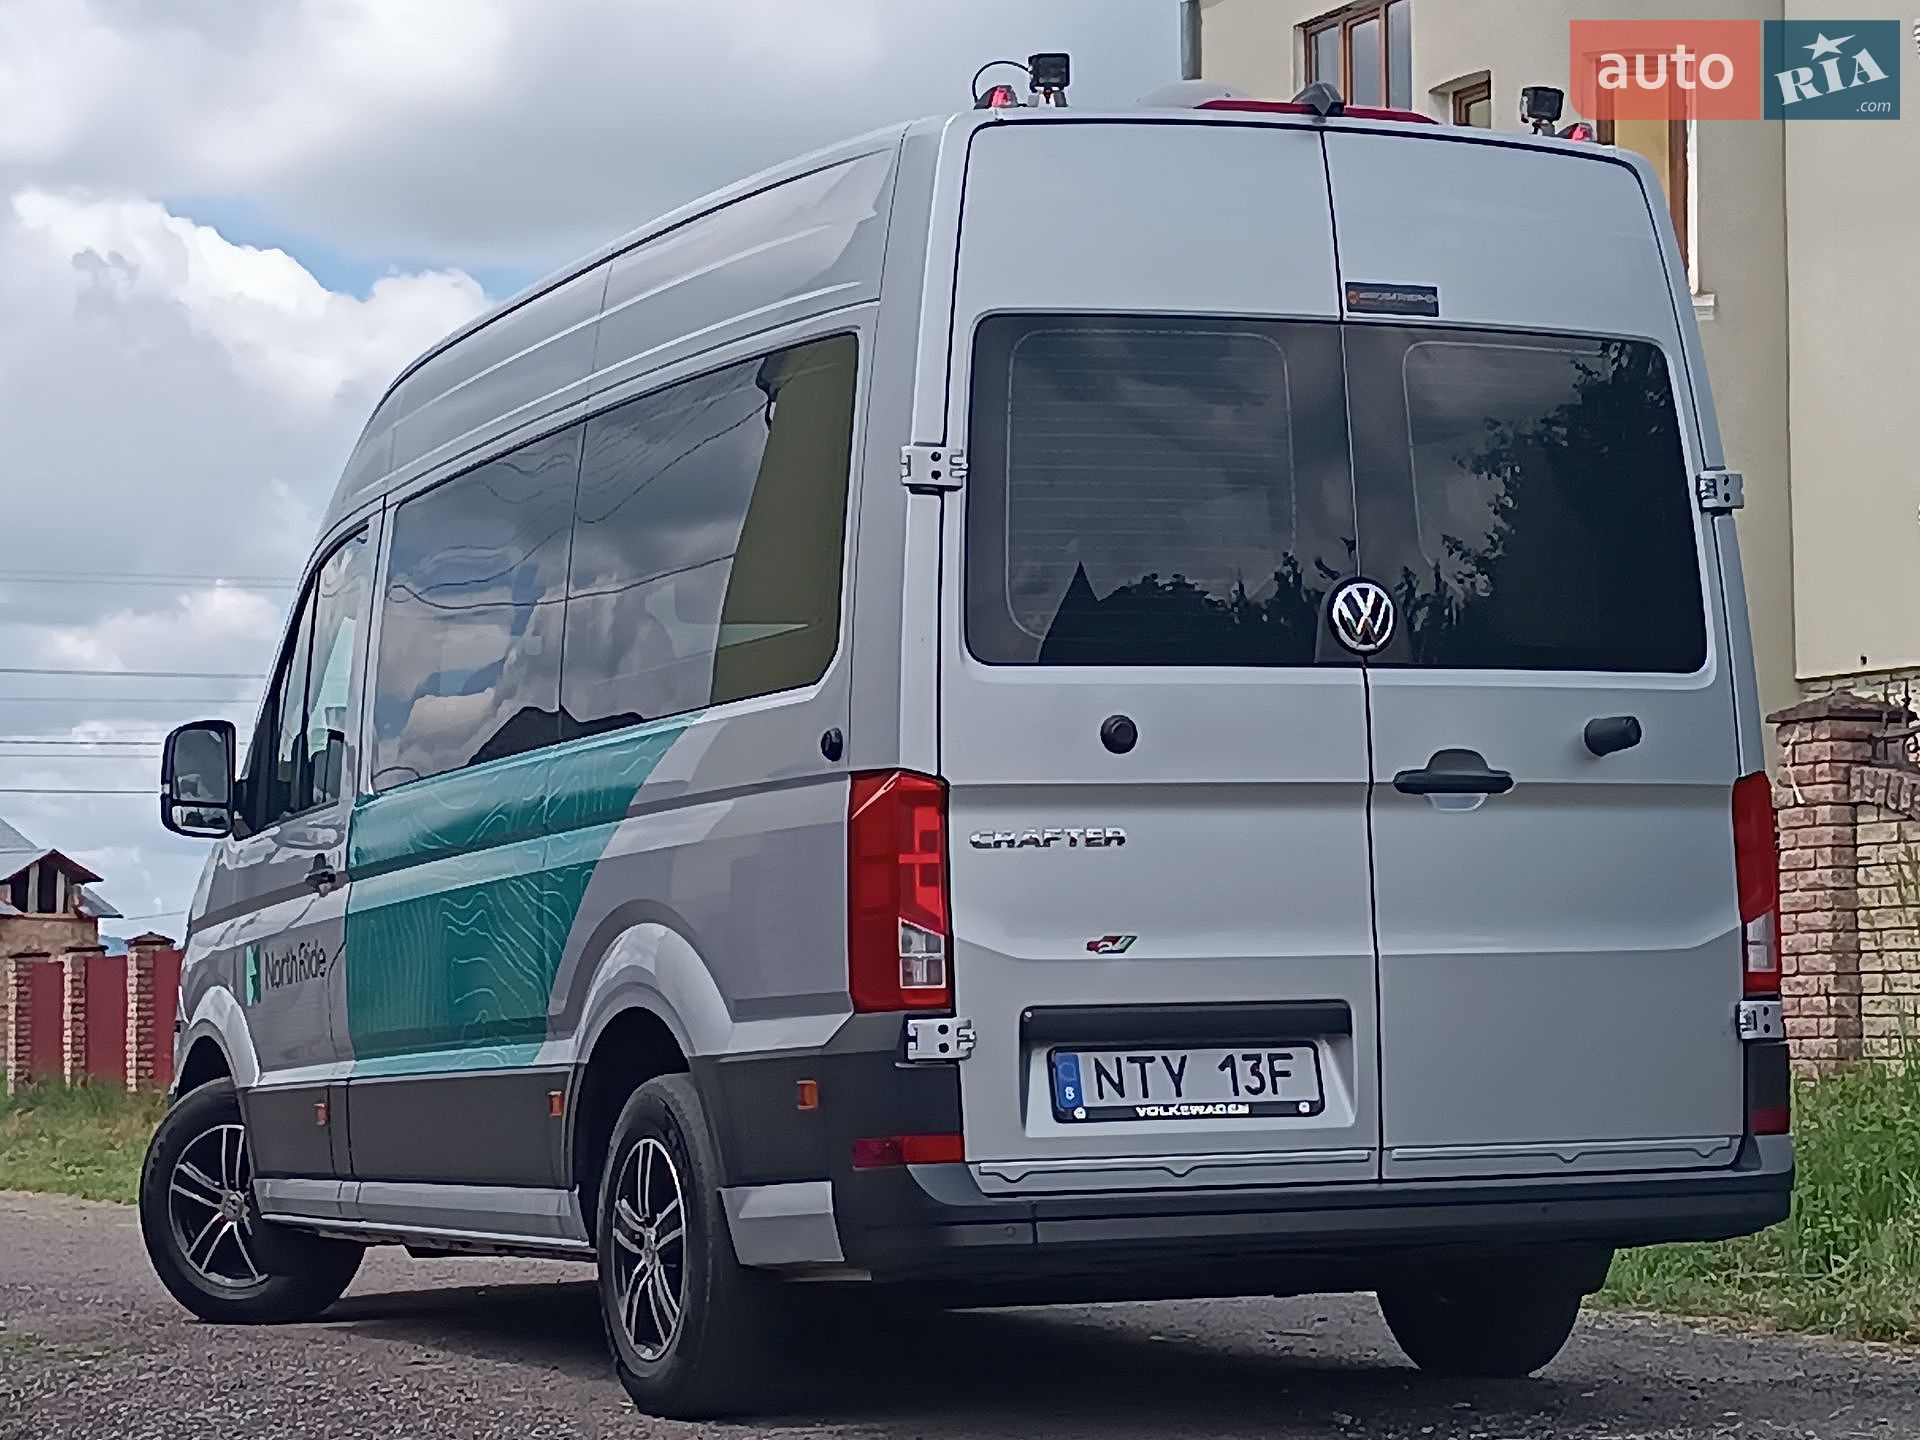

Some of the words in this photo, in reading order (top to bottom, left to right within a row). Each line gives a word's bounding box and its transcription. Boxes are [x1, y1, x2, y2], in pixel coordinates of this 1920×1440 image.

[969, 828, 1127, 849] CRAFTER
[1093, 1054, 1188, 1100] NTY
[1217, 1052, 1294, 1097] 13F
[1135, 1103, 1250, 1118] VOLKSWAGEN
